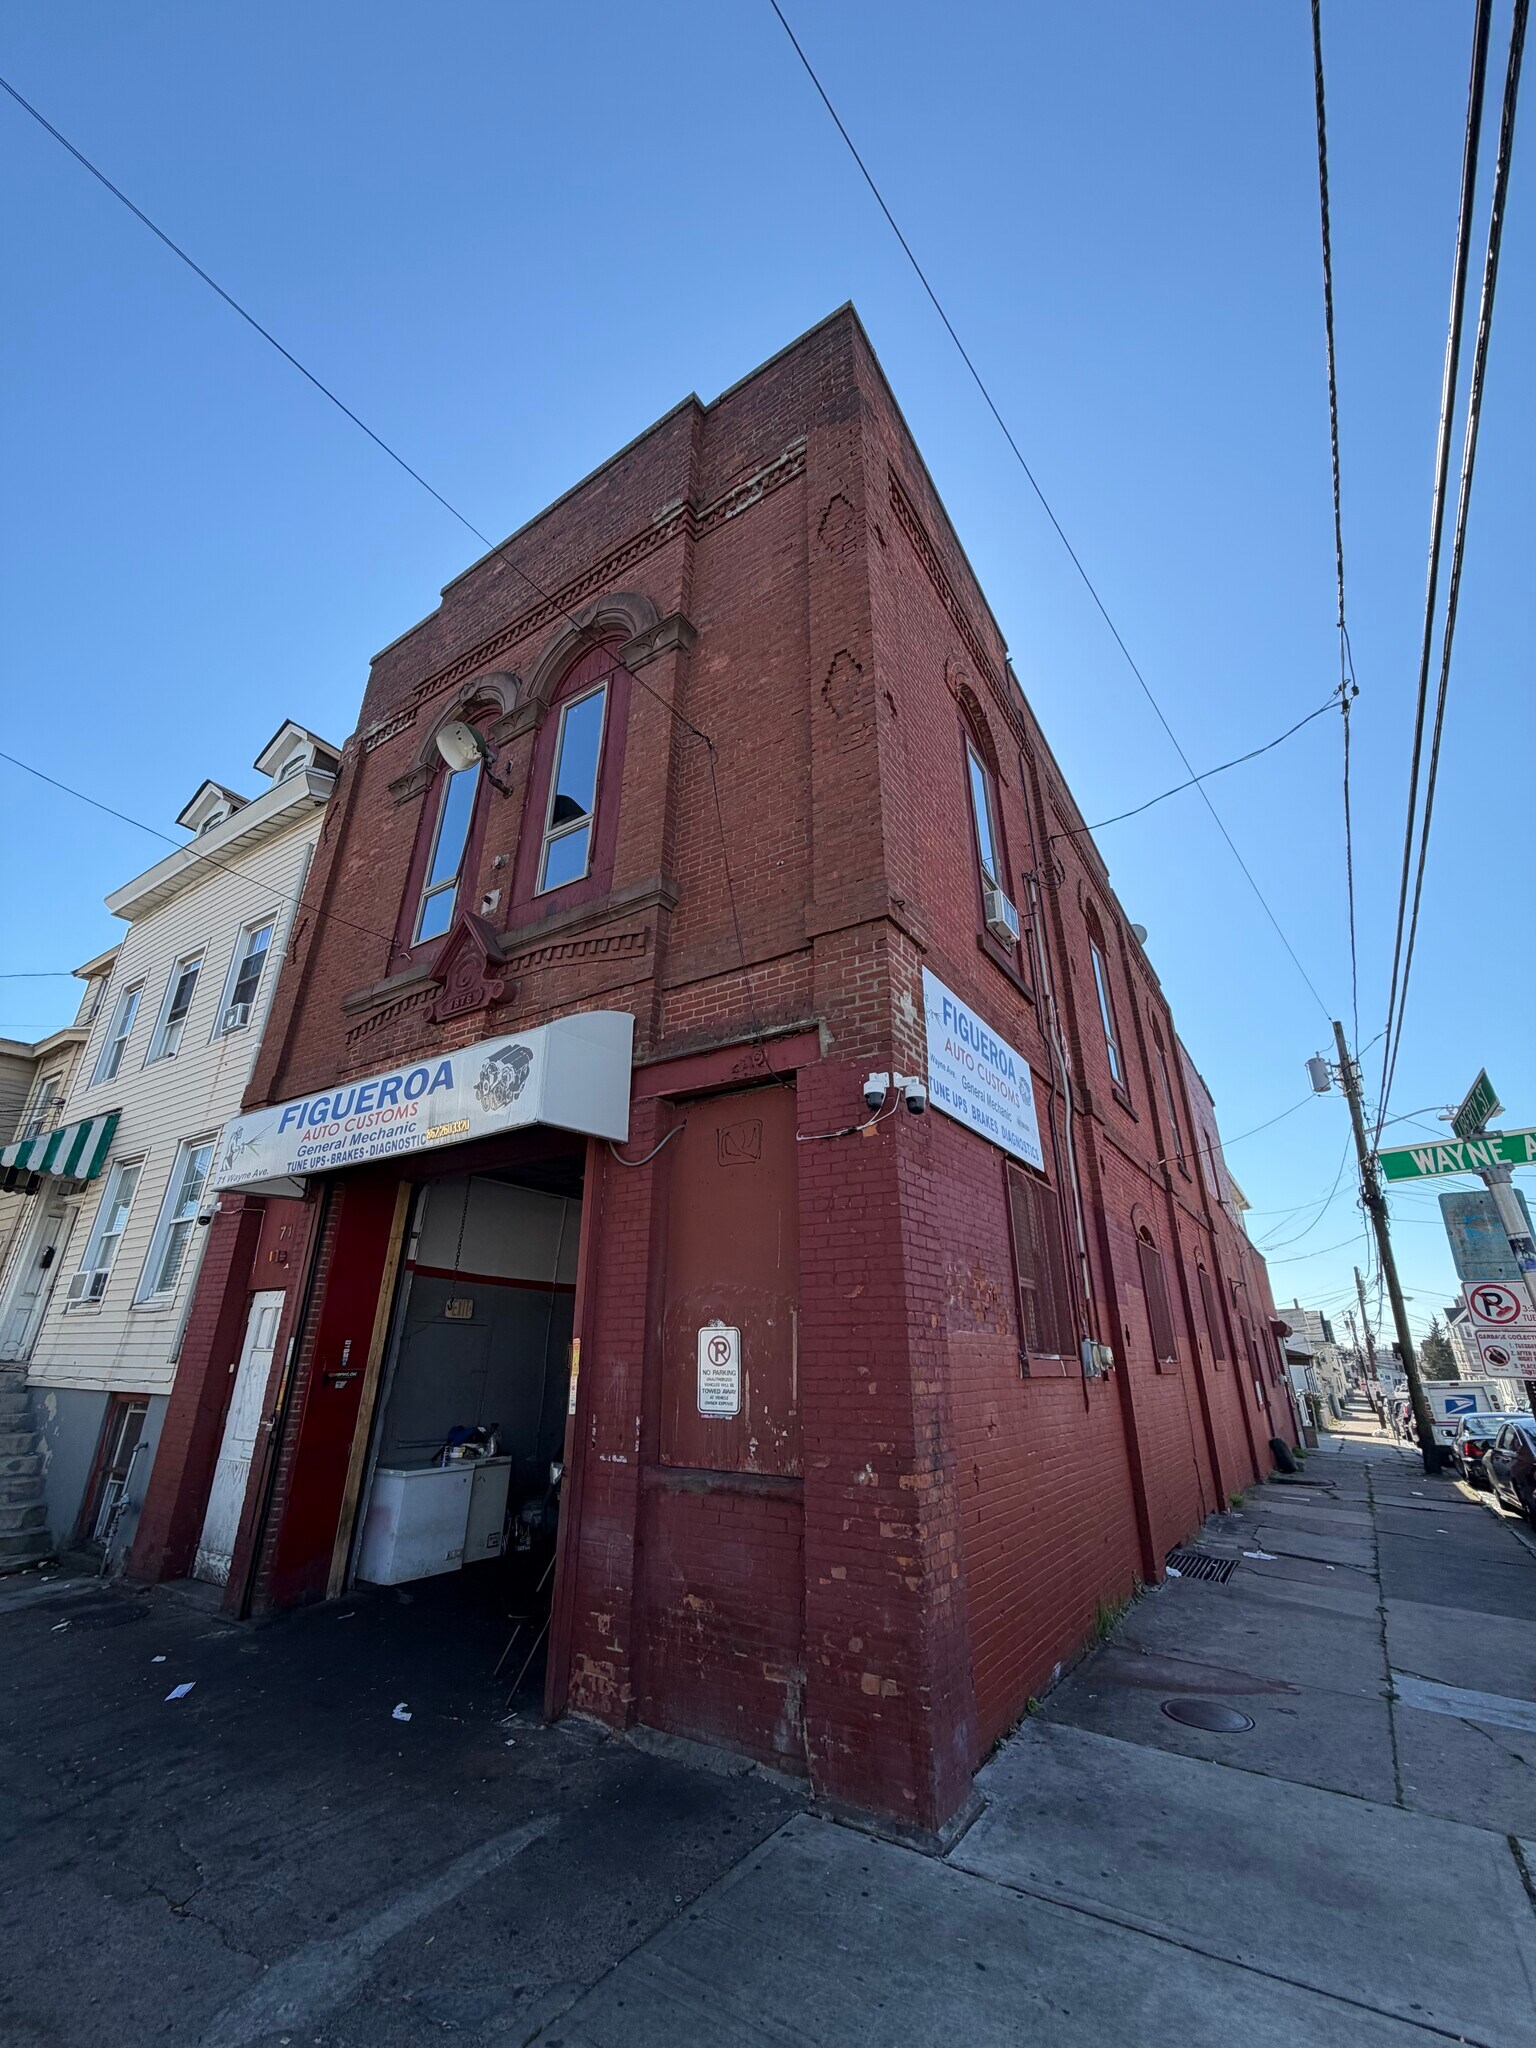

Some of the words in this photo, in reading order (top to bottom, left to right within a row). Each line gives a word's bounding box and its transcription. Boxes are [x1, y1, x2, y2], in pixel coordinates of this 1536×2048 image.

[942, 996, 1017, 1085] FIGUEROA
[944, 1037, 974, 1071] AUTO
[977, 1063, 1020, 1109] CUSTOMS
[961, 1075, 985, 1103] General
[278, 1060, 454, 1134] FIGUEROA
[1475, 1082, 1490, 1113] ST
[301, 1122, 341, 1143] AUTO
[344, 1101, 419, 1133] CUSTOMS
[928, 1076, 951, 1103] TUNE
[952, 1091, 968, 1114] UPS
[971, 1104, 998, 1134] BRAKES
[1001, 1125, 1039, 1161] DIAGNOSTICS
[297, 1136, 347, 1158] General
[350, 1121, 416, 1147] Mechanic
[1410, 1138, 1512, 1175] WAYNE
[217, 1176, 226, 1185] 71
[227, 1172, 252, 1183] Wayne
[252, 1168, 269, 1178] Ave.
[287, 1158, 307, 1173] TUNE
[310, 1155, 326, 1169] UPS
[330, 1146, 365, 1166] BRAKES
[279, 1224, 293, 1241] 71
